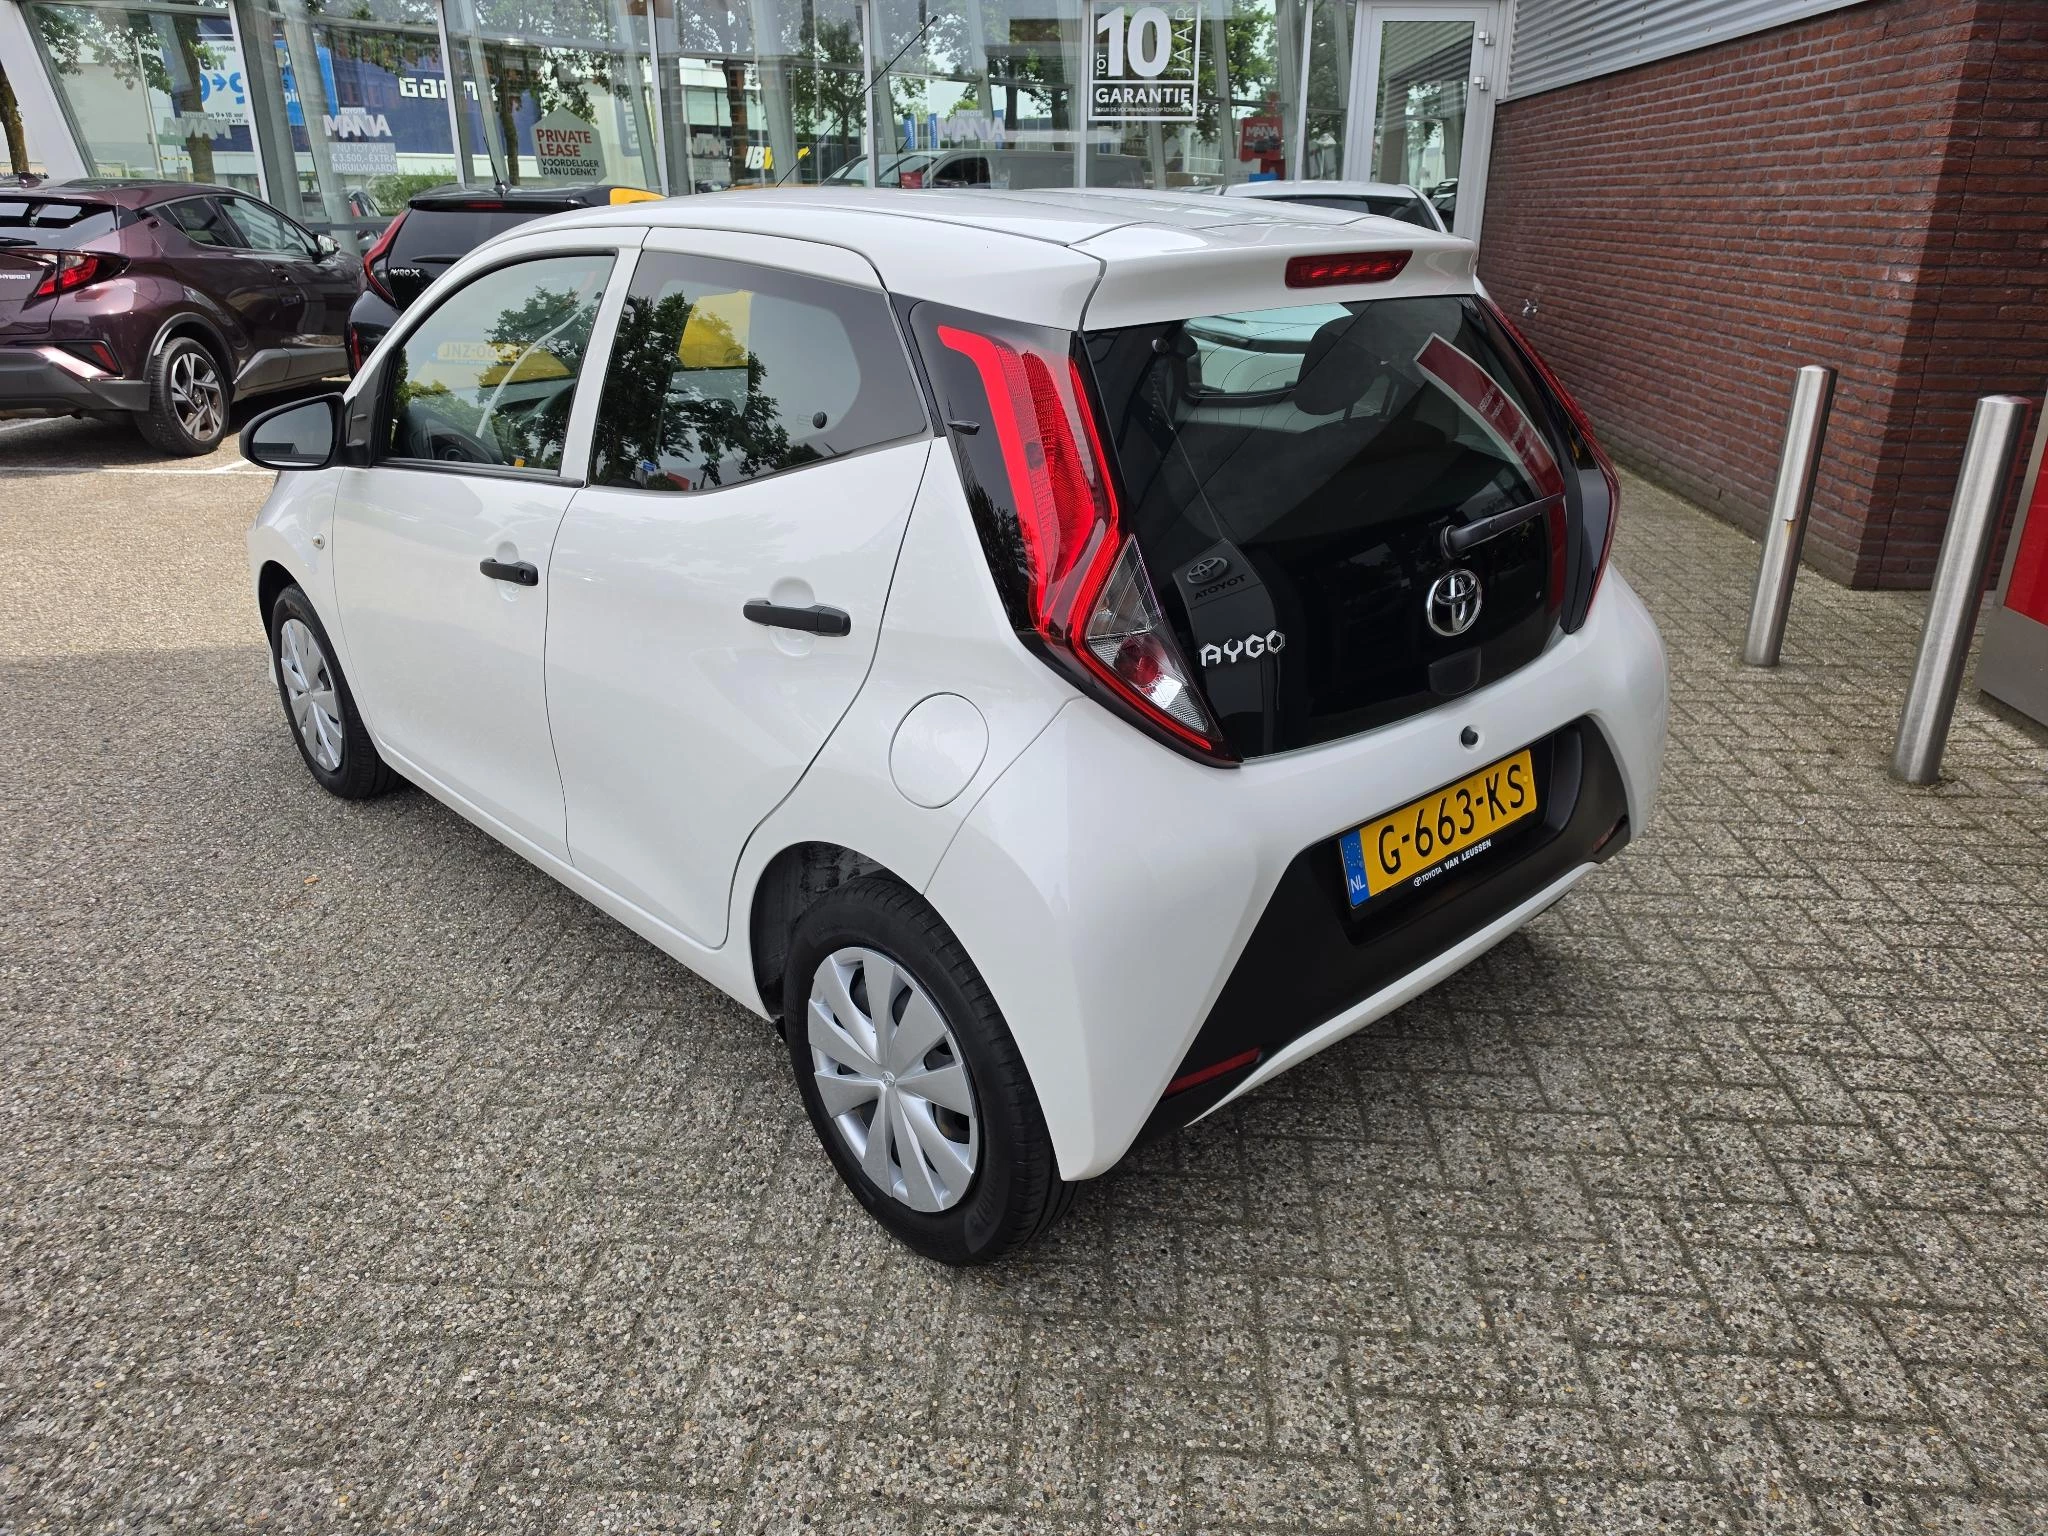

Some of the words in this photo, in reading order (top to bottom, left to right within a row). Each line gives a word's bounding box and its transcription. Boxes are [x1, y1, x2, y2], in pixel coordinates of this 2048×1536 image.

[1097, 6, 1172, 77] 10
[1173, 7, 1193, 76] JAAR
[1096, 52, 1107, 76] TOT
[1095, 87, 1191, 104] GARANTIE
[536, 129, 592, 144] PRIVATE
[369, 154, 397, 163] EXTRA
[539, 143, 581, 157] LEASE
[541, 159, 600, 168] VOORDELIGER
[543, 167, 562, 176] DAN
[563, 167, 569, 176] U
[570, 168, 598, 177] DENKT
[1200, 630, 1285, 667] AYGO
[1378, 764, 1525, 875] G-663-KS
[1421, 867, 1442, 882] TOYOTA
[1445, 856, 1459, 870] VAN
[1461, 839, 1492, 861] LEUSSEN
[1350, 874, 1366, 893] NL
